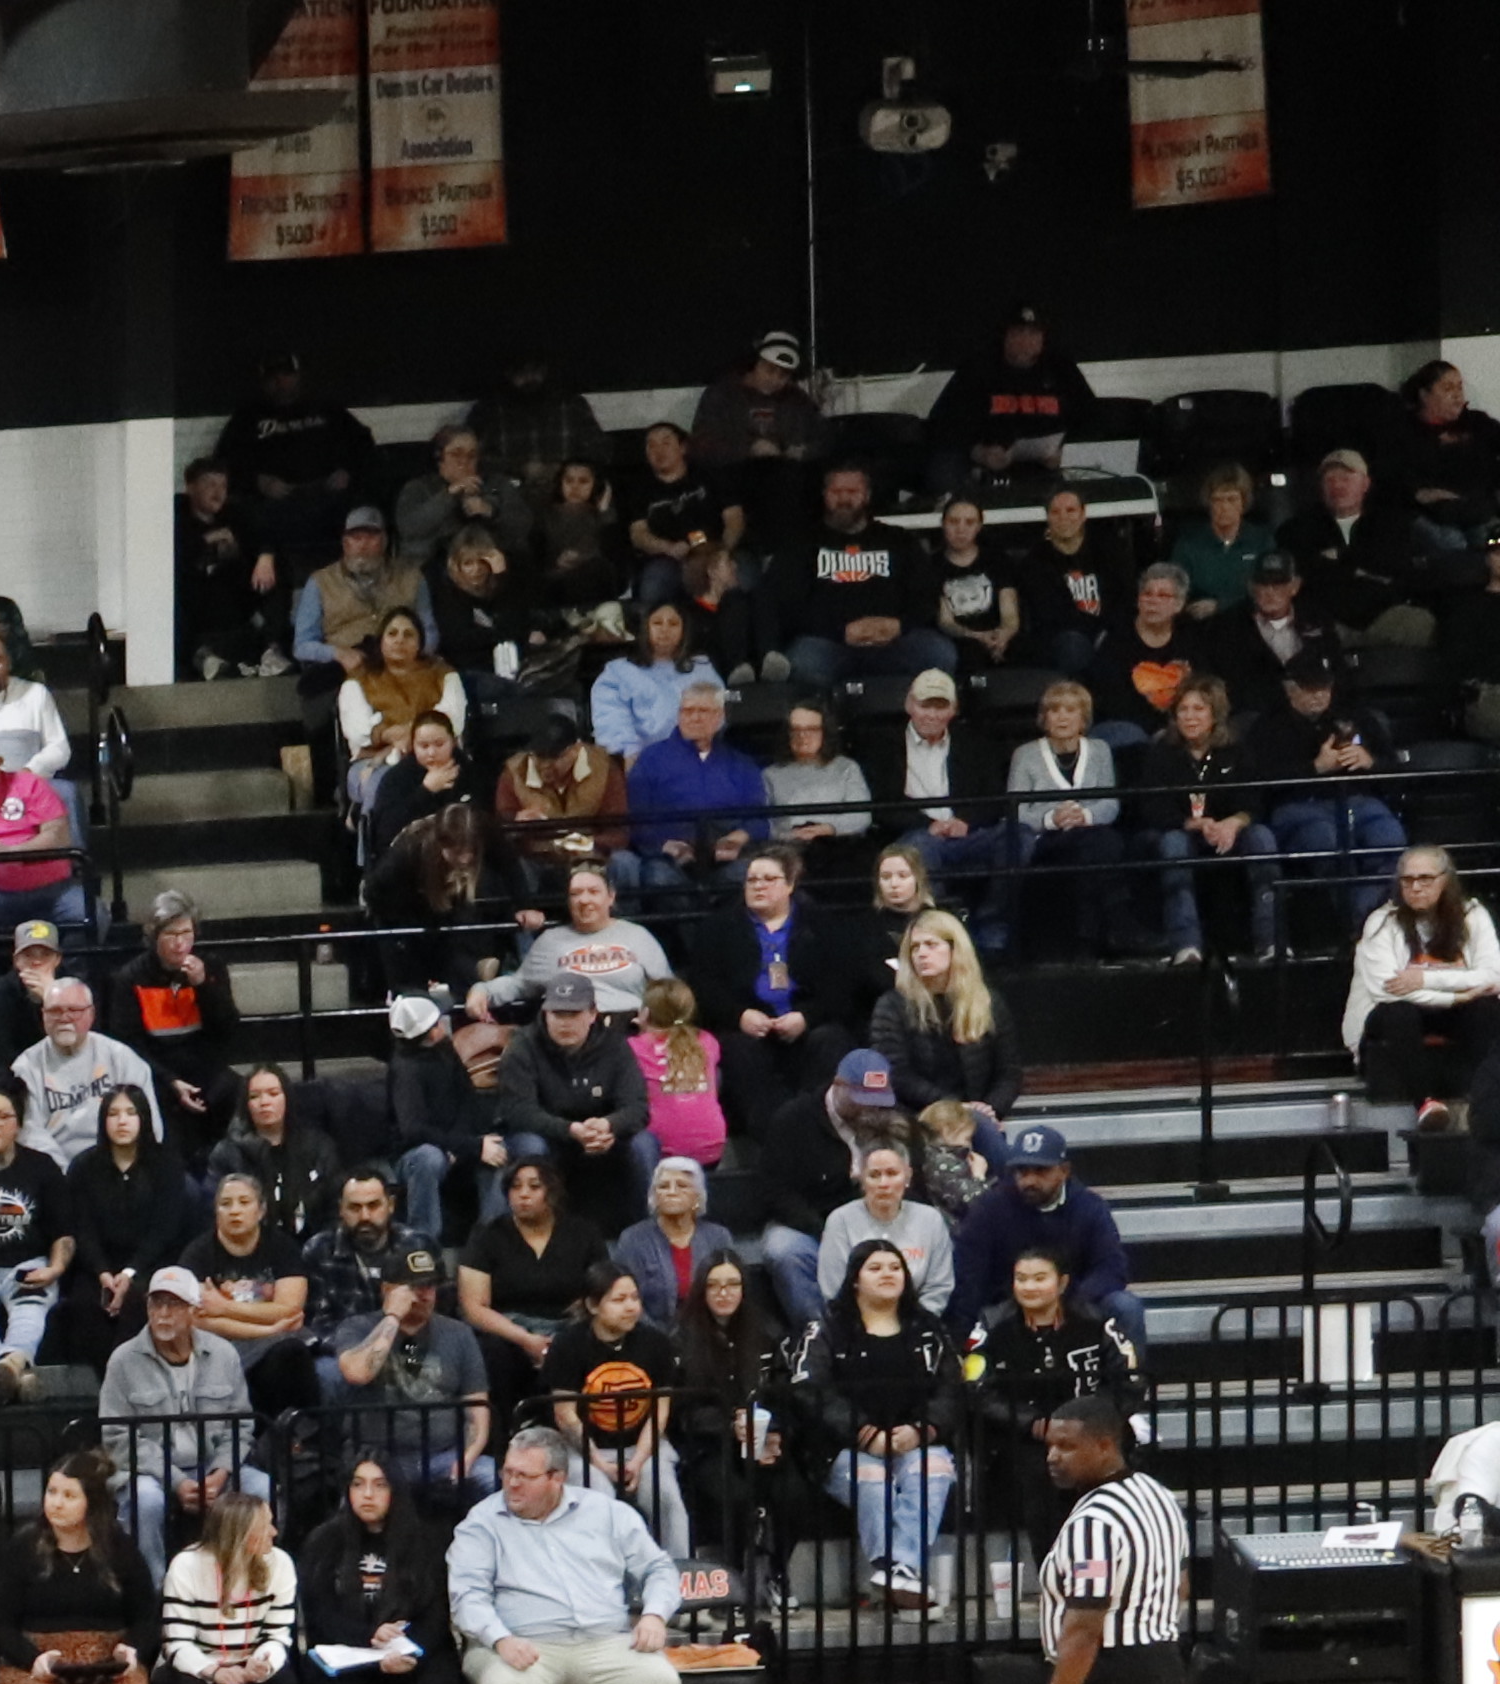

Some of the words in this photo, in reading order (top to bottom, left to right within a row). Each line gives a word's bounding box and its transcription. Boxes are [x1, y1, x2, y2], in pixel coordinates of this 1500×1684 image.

[276, 223, 313, 249] $500
[420, 214, 457, 239] $500
[816, 546, 891, 580] DUMAS
[557, 950, 639, 969] DUMAS
[45, 1072, 113, 1114] DEMONS
[679, 1571, 730, 1599] MAS
